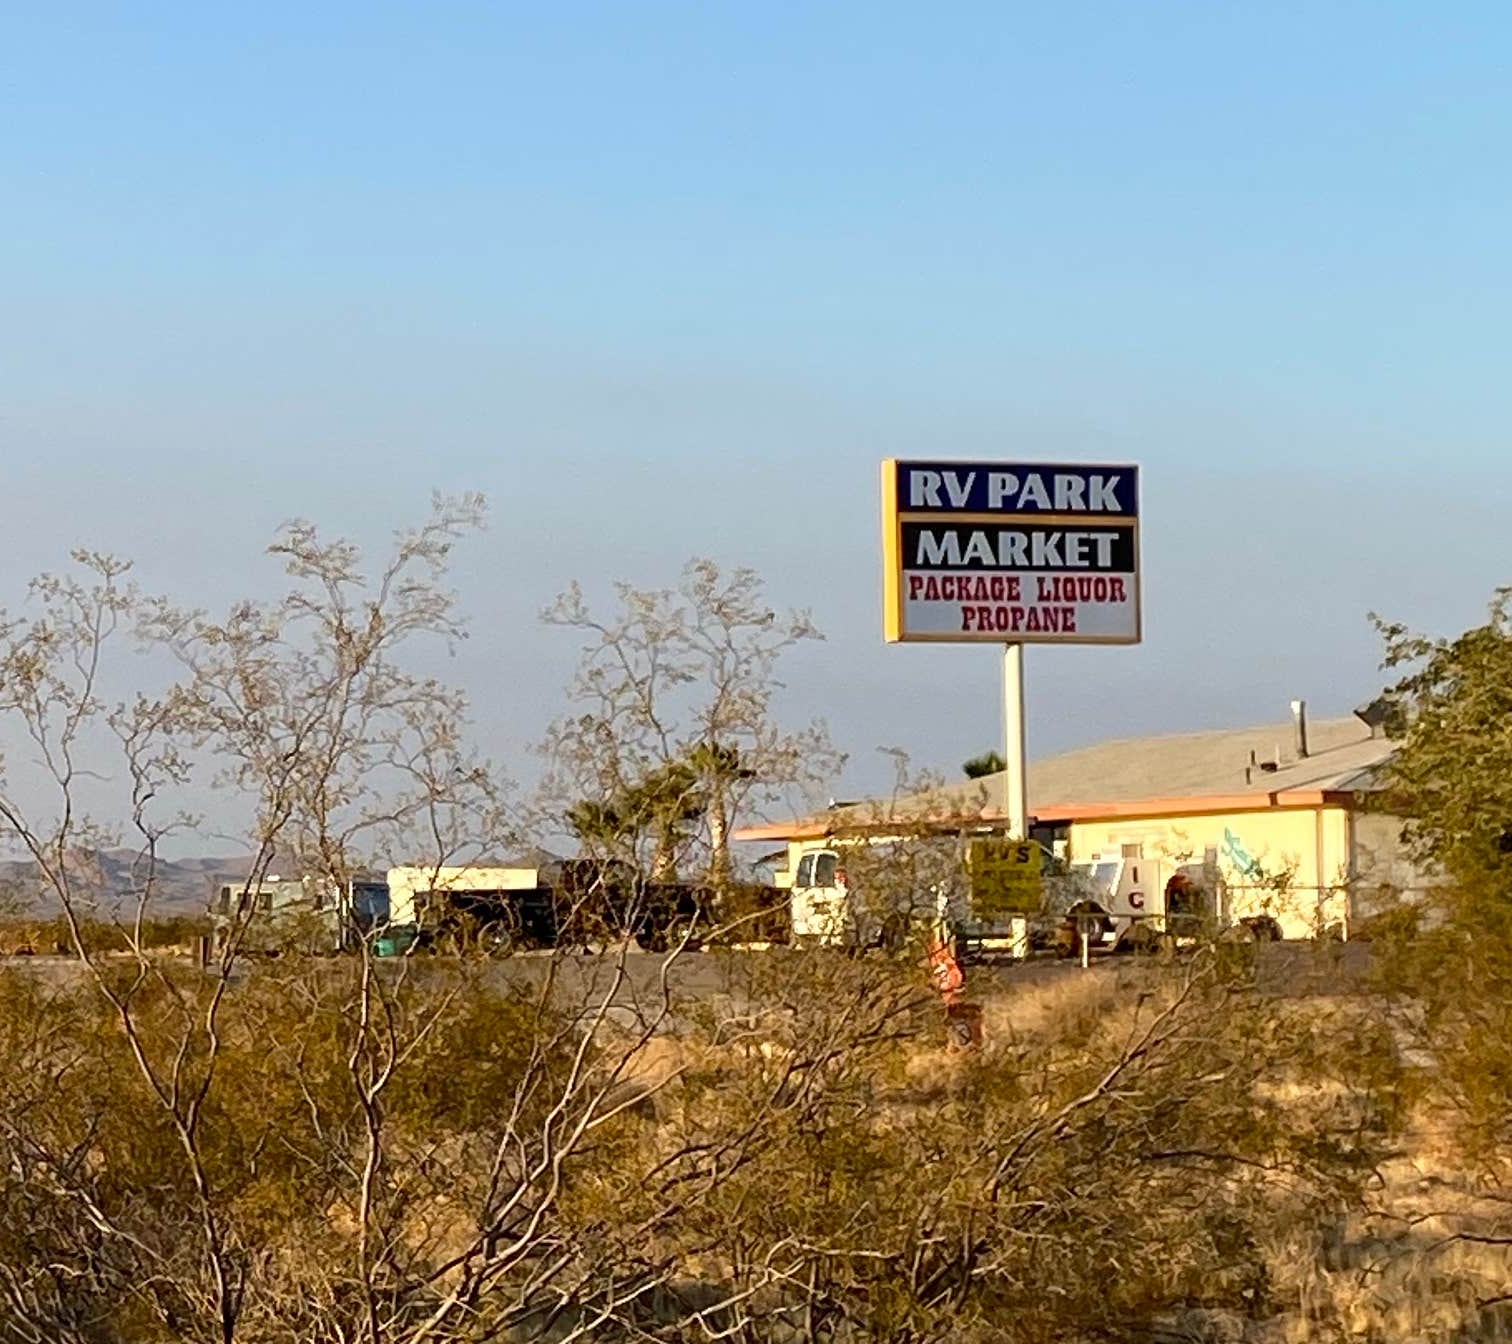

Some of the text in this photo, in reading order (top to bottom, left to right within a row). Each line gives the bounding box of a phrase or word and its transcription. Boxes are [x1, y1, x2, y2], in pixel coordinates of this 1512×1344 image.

[909, 469, 1122, 511] RV PARK
[916, 529, 1119, 567] MARKET
[909, 575, 1127, 602] PACKAGE LIQUOR
[961, 606, 1076, 633] PROPANE
